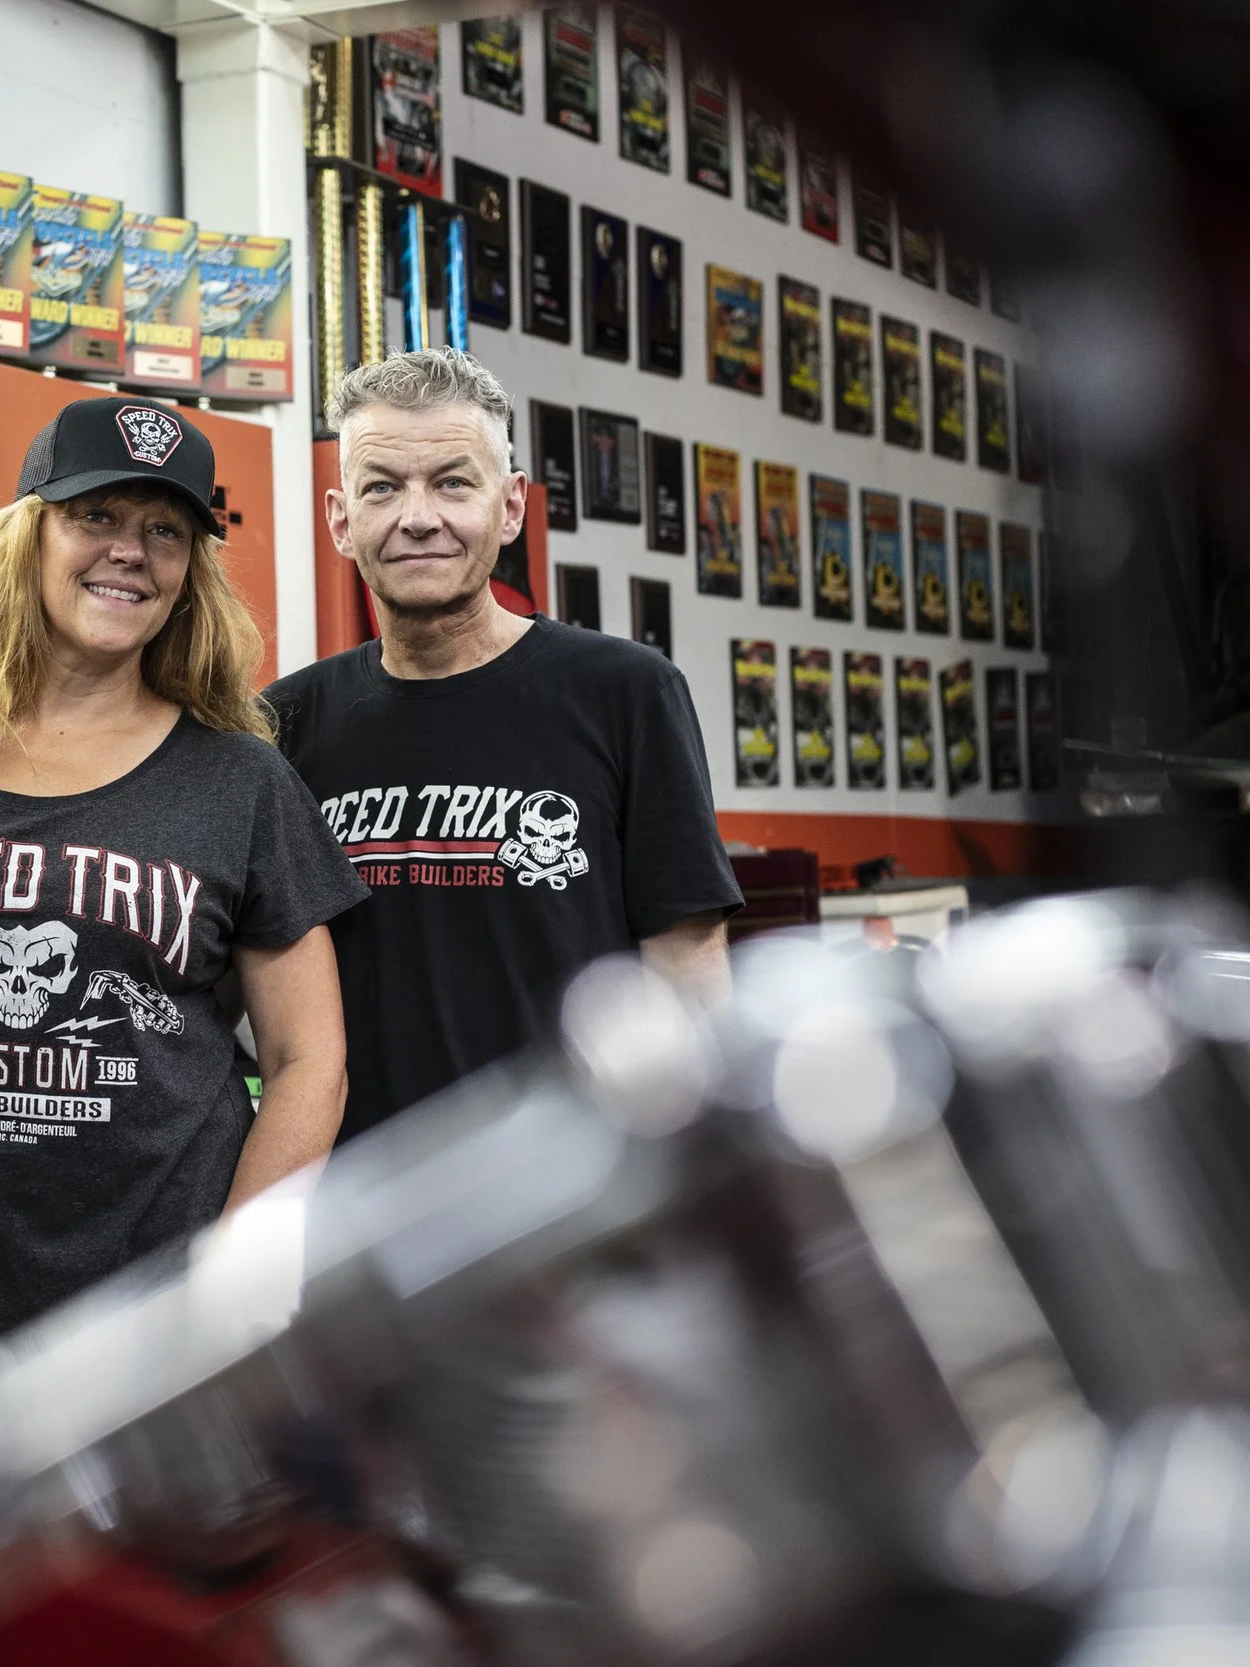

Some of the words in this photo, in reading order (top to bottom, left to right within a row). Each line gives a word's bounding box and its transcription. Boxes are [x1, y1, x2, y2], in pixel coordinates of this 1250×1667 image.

[31, 296, 69, 325] WARD
[121, 411, 156, 424] SPEED
[158, 416, 178, 438] TRIX
[416, 785, 523, 839] TRIX
[358, 865, 402, 886] BIKE
[409, 864, 506, 887] BUILDERS
[62, 842, 202, 976] TRIX
[98, 1060, 137, 1081] 1996
[9, 1133, 38, 1145] CANADA
